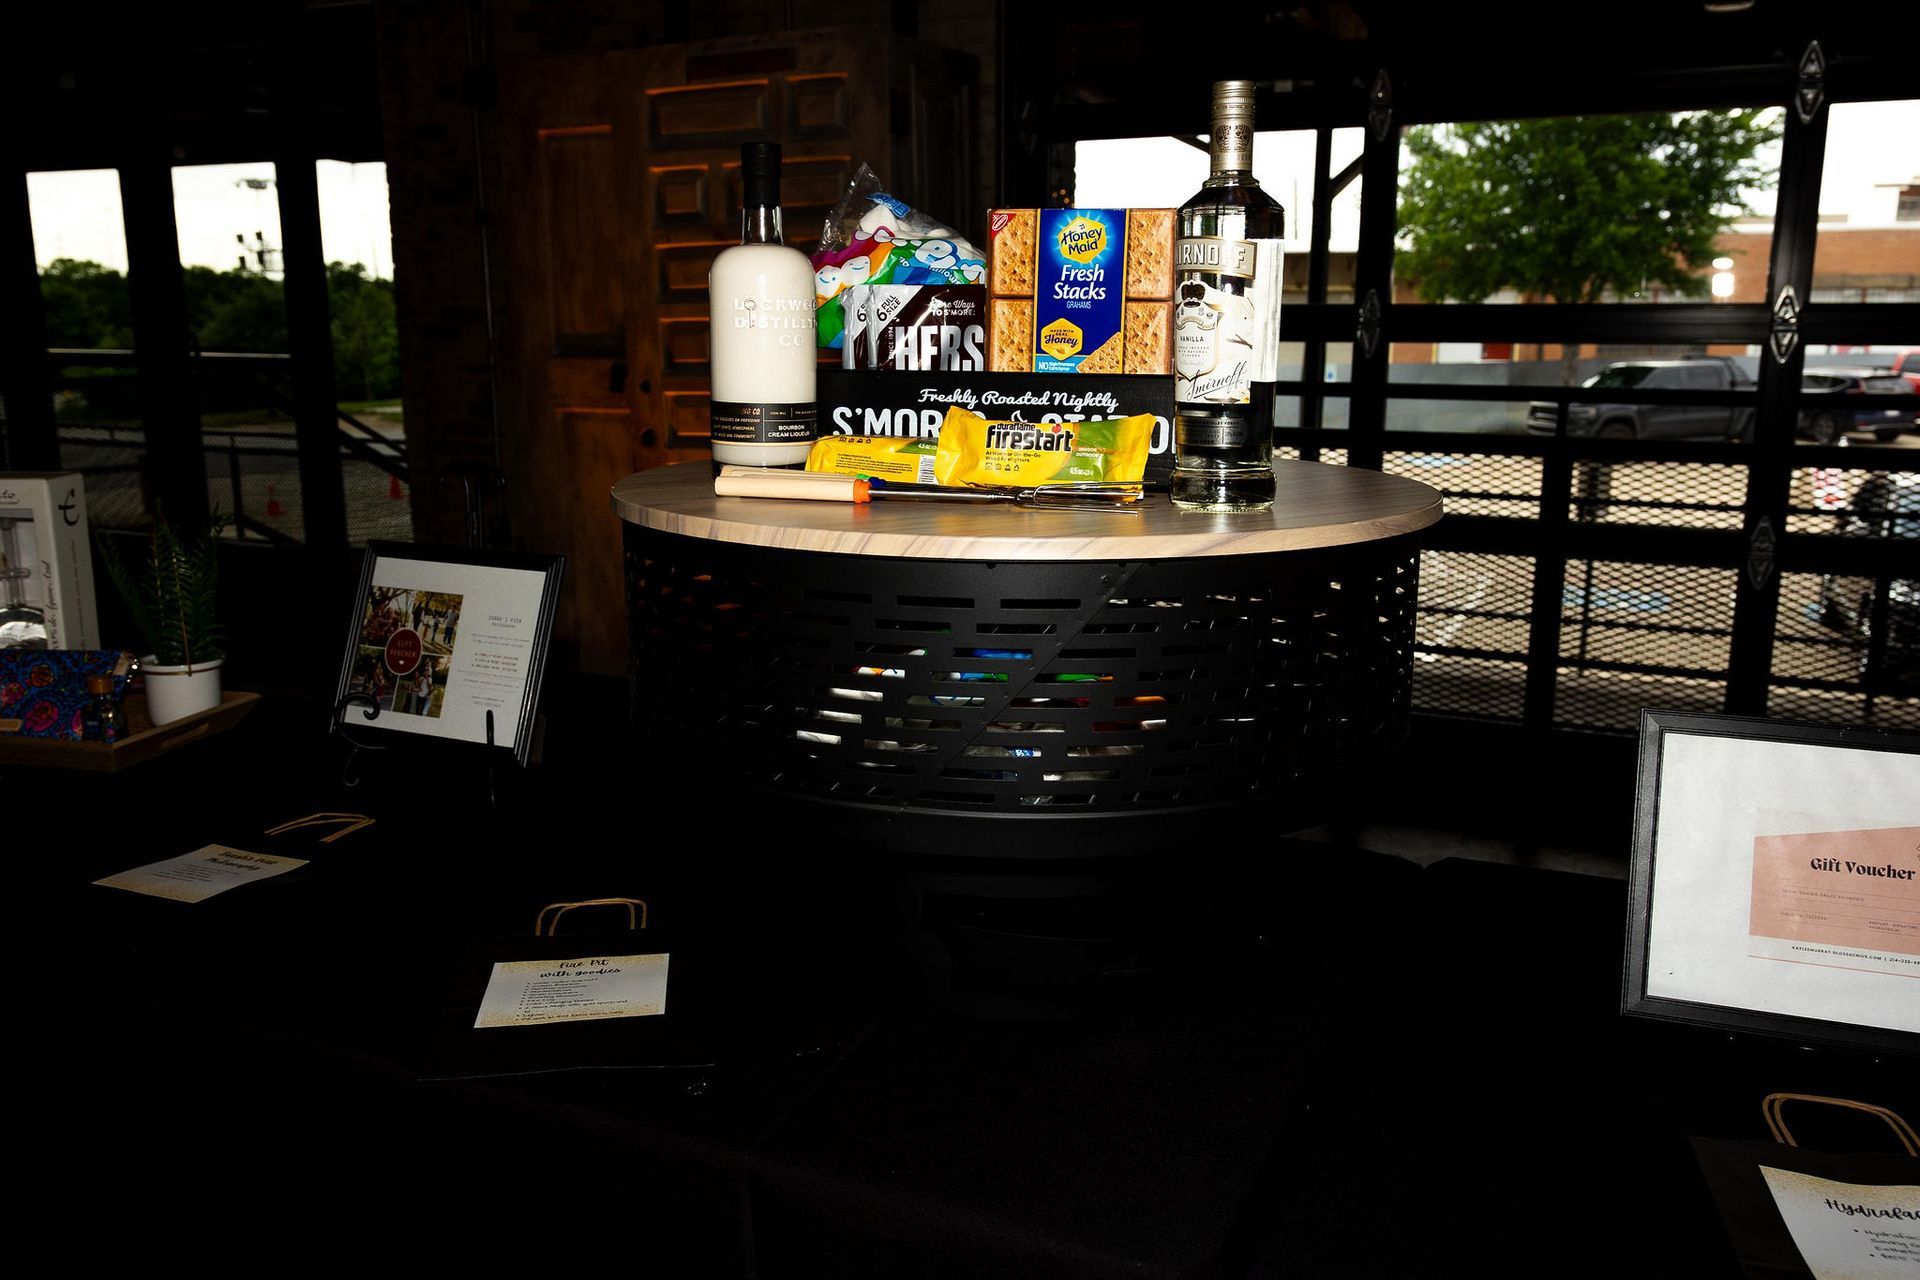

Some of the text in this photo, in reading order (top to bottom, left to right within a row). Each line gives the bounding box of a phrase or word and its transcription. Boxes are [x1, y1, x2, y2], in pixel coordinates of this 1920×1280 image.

[1061, 228, 1103, 245] Honey
[1068, 239, 1099, 255] Maid
[1061, 264, 1105, 282] Fresh
[1053, 282, 1107, 300] Stacks
[881, 294, 897, 311] FULL
[886, 298, 902, 315] SIZE
[953, 299, 976, 310] Ways
[1066, 301, 1092, 309] GRAHAMS
[877, 309, 888, 322] 6
[1044, 335, 1079, 348] Honey
[1038, 361, 1049, 370] NO
[1187, 361, 1248, 401] Smirnoff
[918, 389, 1119, 413] Freshly Roasted Nightly
[833, 407, 984, 438] S'MOR
[997, 423, 1036, 432] duraflame
[985, 424, 1074, 453] firestart
[1810, 857, 1917, 880] Gift Voucher
[540, 968, 622, 978] with goodies
[559, 961, 585, 969] Fire
